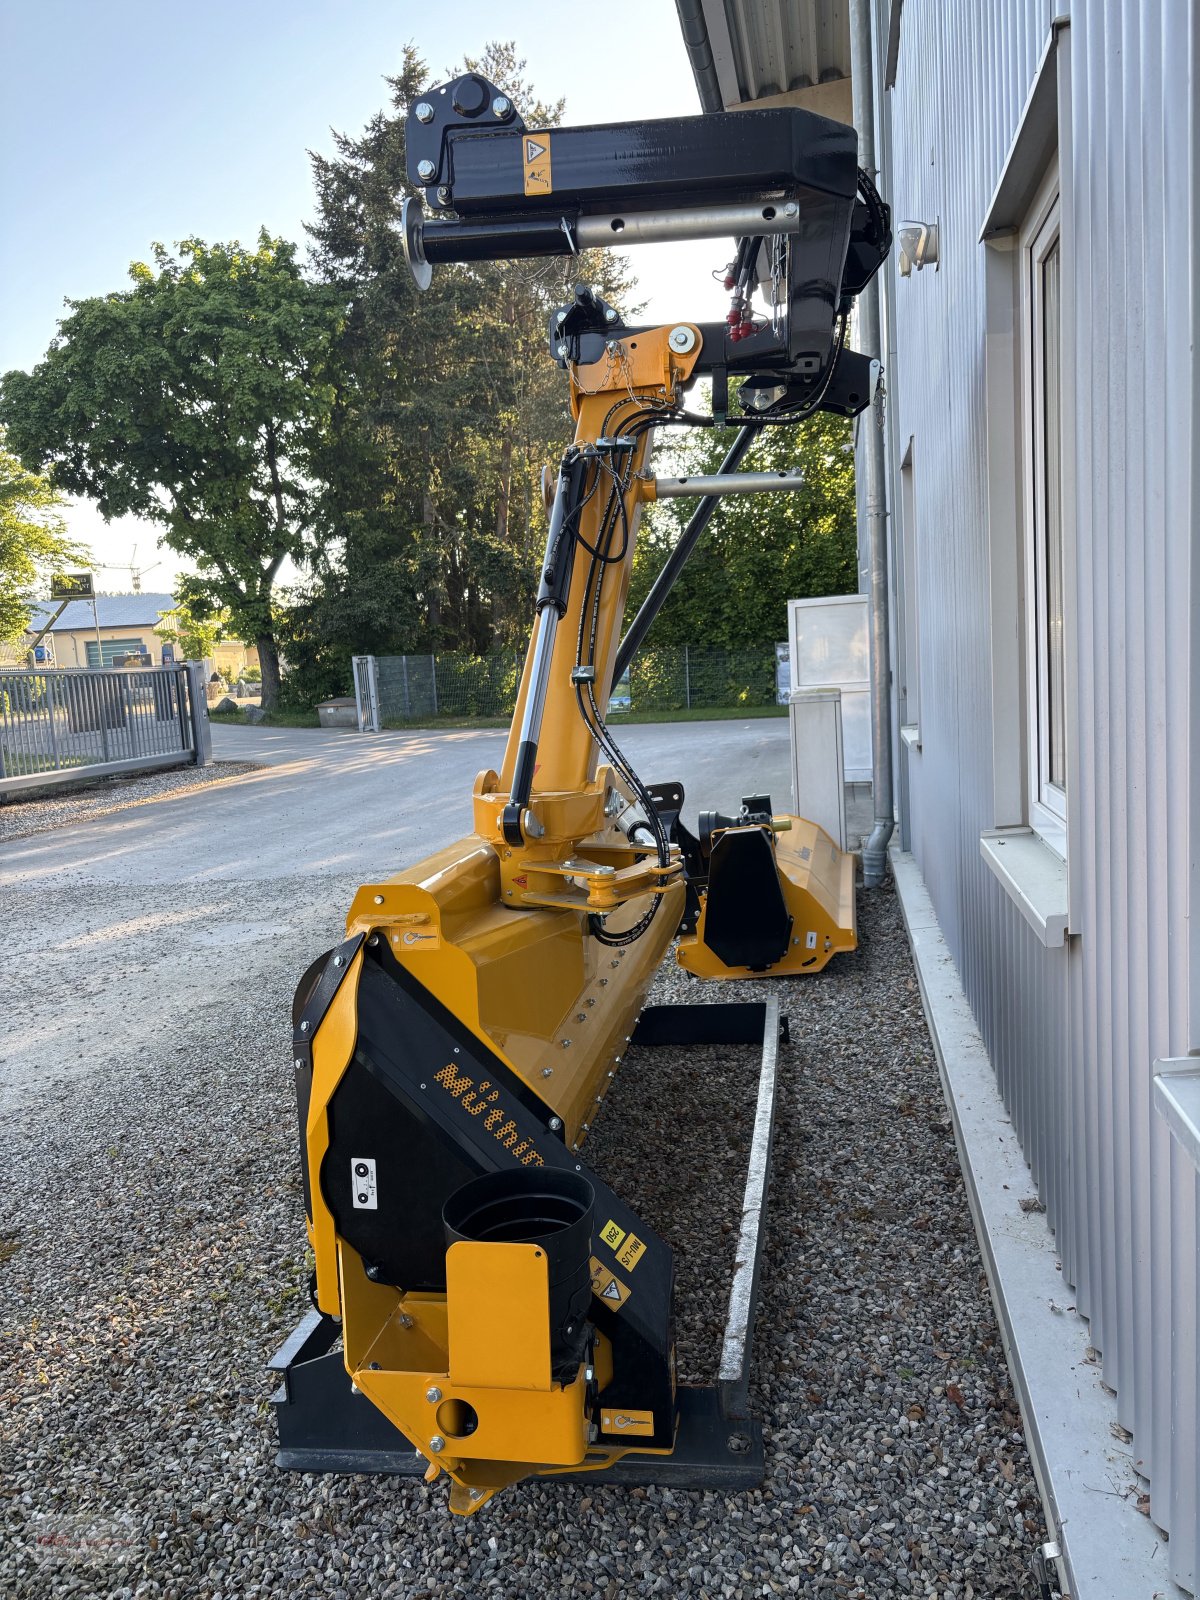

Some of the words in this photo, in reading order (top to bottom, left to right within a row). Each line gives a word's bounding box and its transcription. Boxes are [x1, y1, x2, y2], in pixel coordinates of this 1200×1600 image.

[433, 1062, 544, 1167] Müthin
[606, 1226, 620, 1243] 250
[621, 1239, 641, 1266] MU-L/S
